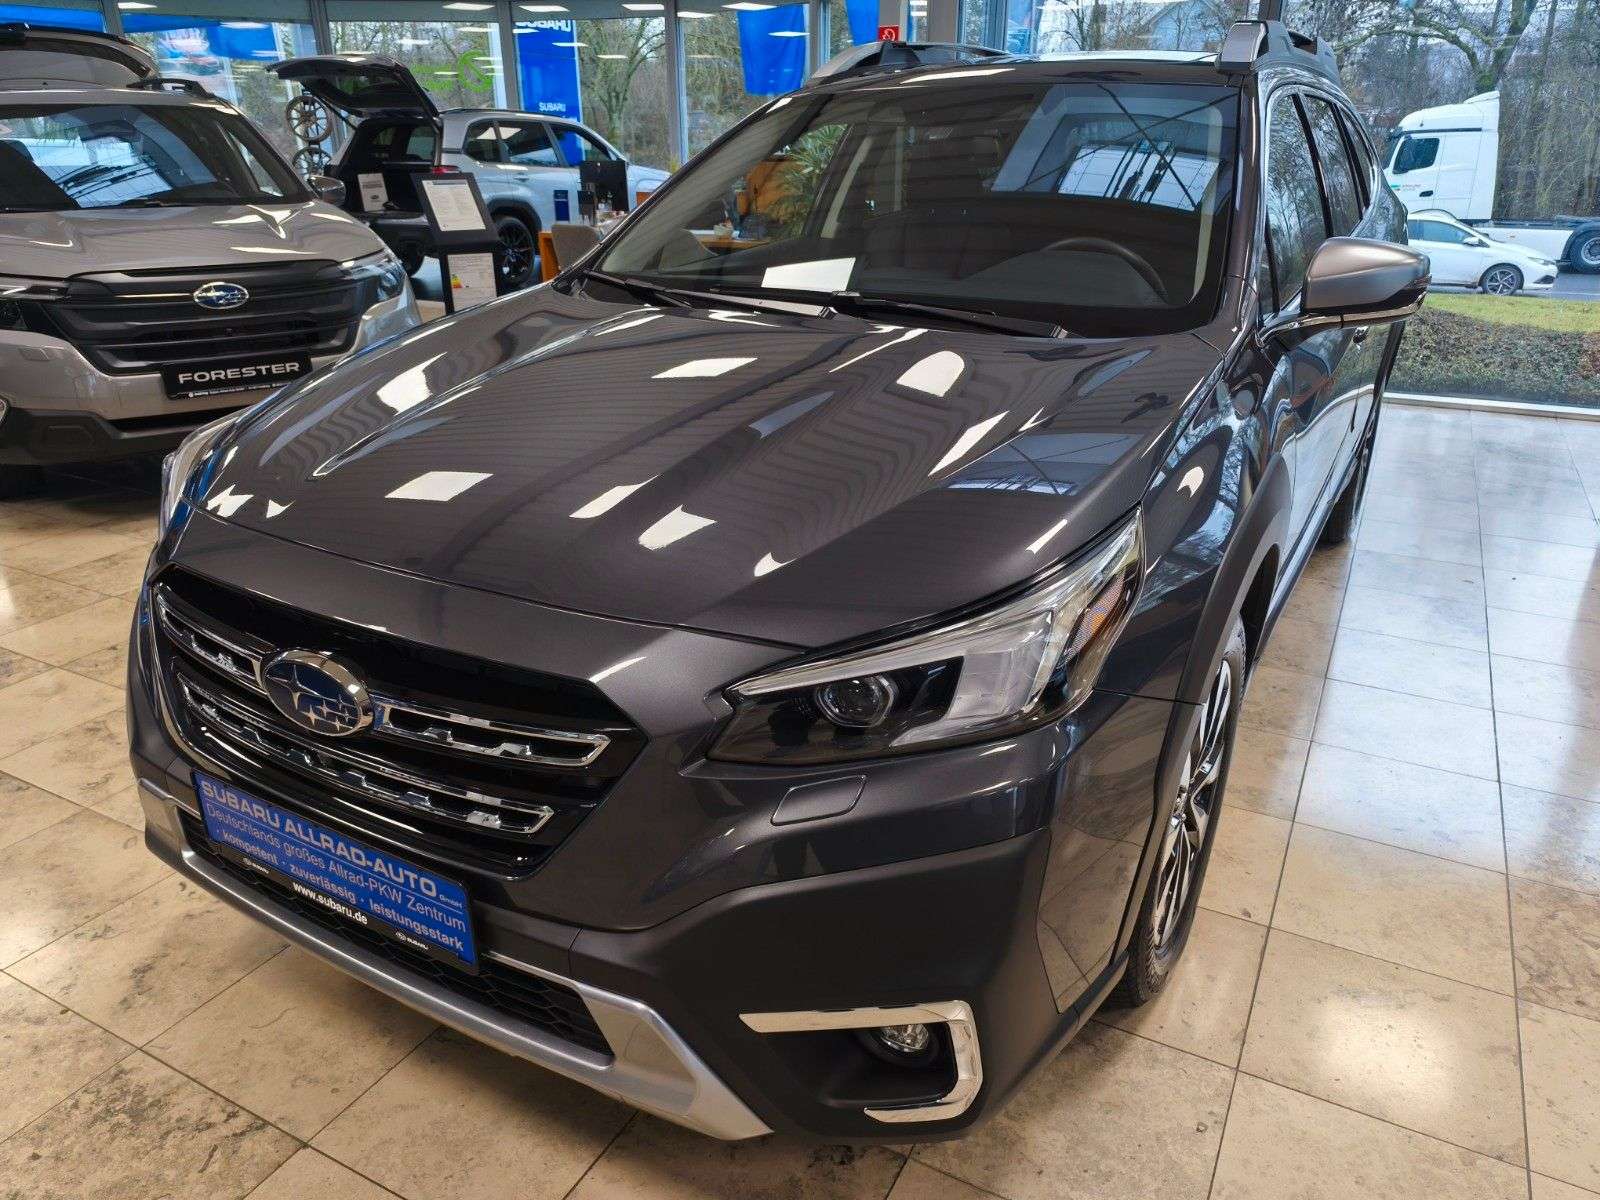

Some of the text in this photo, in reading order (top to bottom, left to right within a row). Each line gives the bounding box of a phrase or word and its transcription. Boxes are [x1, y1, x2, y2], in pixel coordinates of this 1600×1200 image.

[539, 102, 566, 112] SUBARU
[178, 362, 300, 384] FORESTER
[200, 781, 280, 829] SUBARU
[285, 818, 437, 897] ALLRAD-AUTO
[206, 803, 466, 933] Deutschlands großes Allrad-PKW Zentrum
[222, 829, 463, 951] kompetent zuverlässig leistungsstark
[292, 882, 368, 925] www.subaru.de
